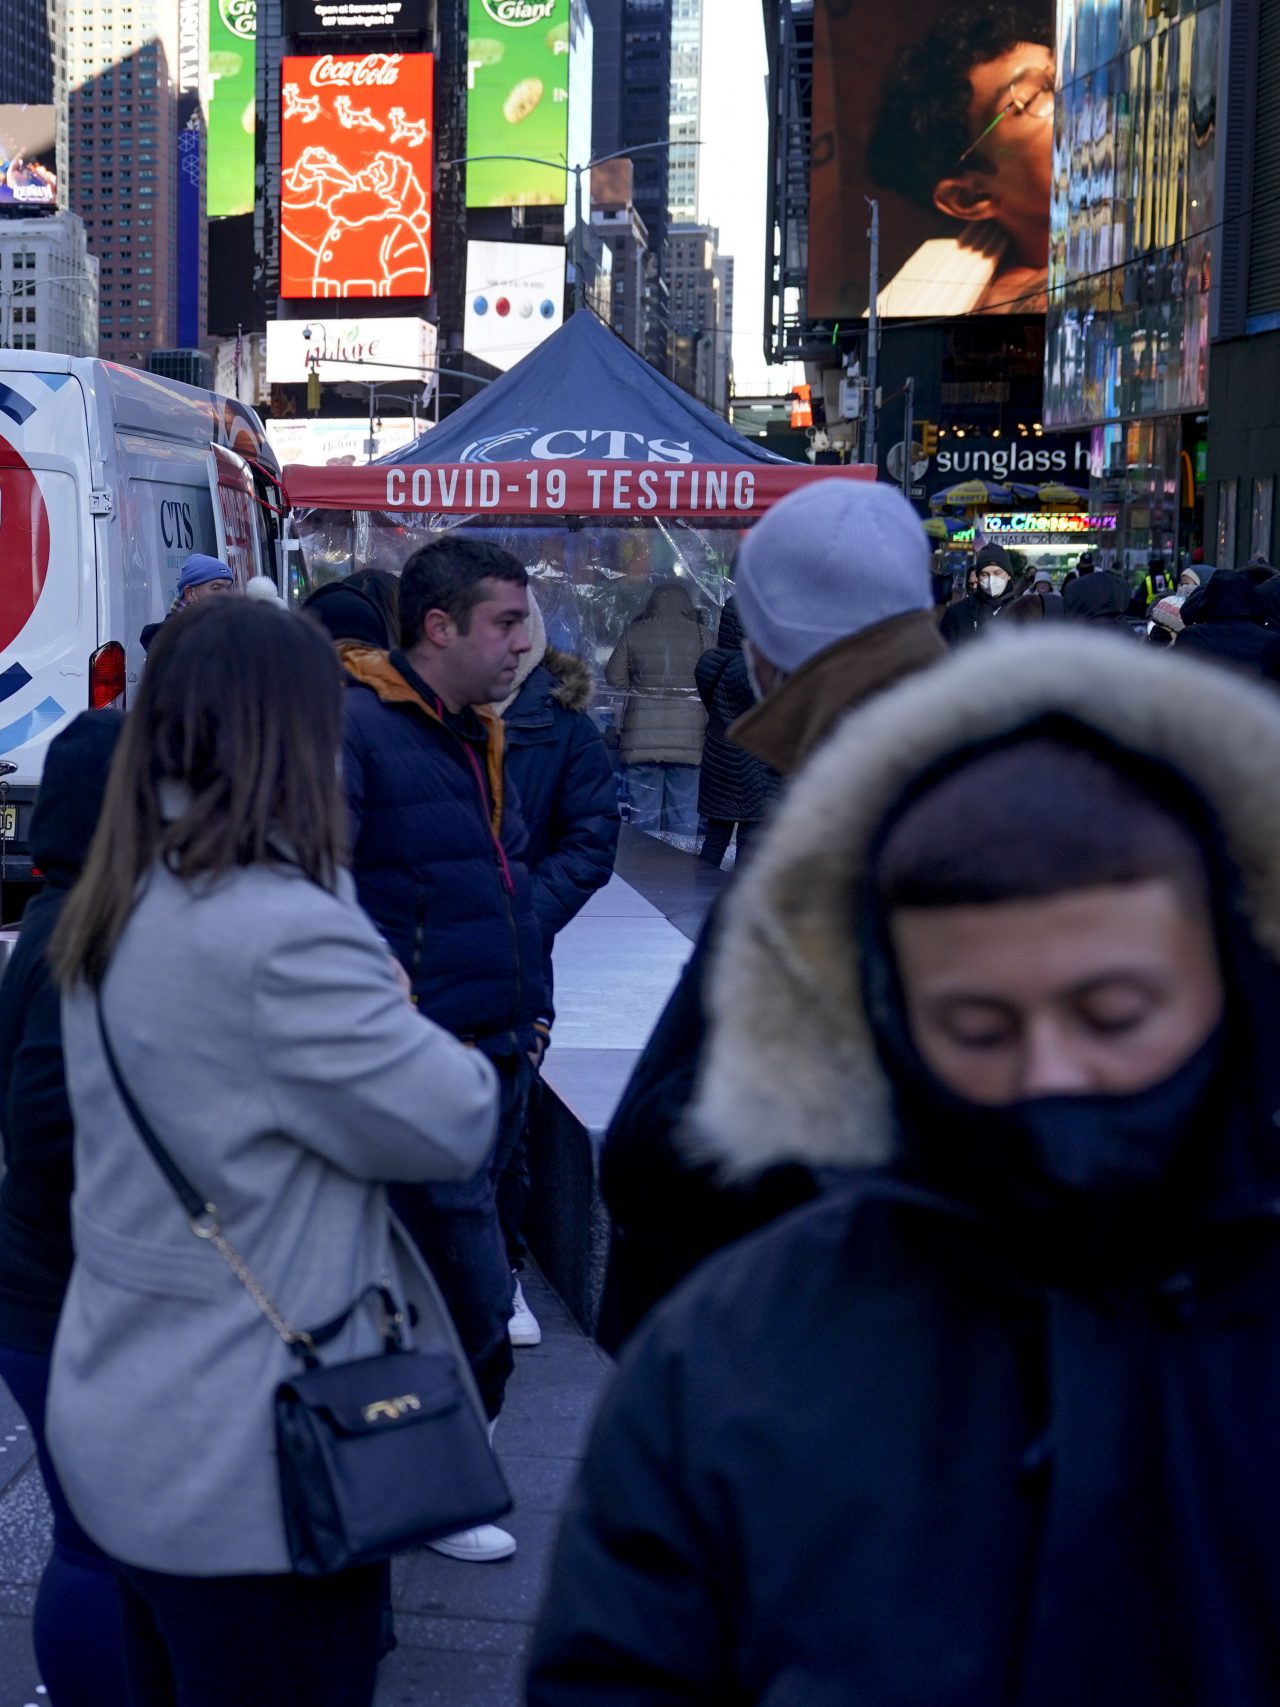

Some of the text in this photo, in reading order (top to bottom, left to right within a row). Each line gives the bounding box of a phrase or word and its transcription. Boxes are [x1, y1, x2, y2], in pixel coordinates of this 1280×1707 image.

[497, 0, 555, 20] Giant
[531, 429, 694, 464] CTS
[936, 441, 1067, 480] sunglass
[386, 468, 755, 510] COVID-19 TESTING
[160, 499, 194, 550] CTS
